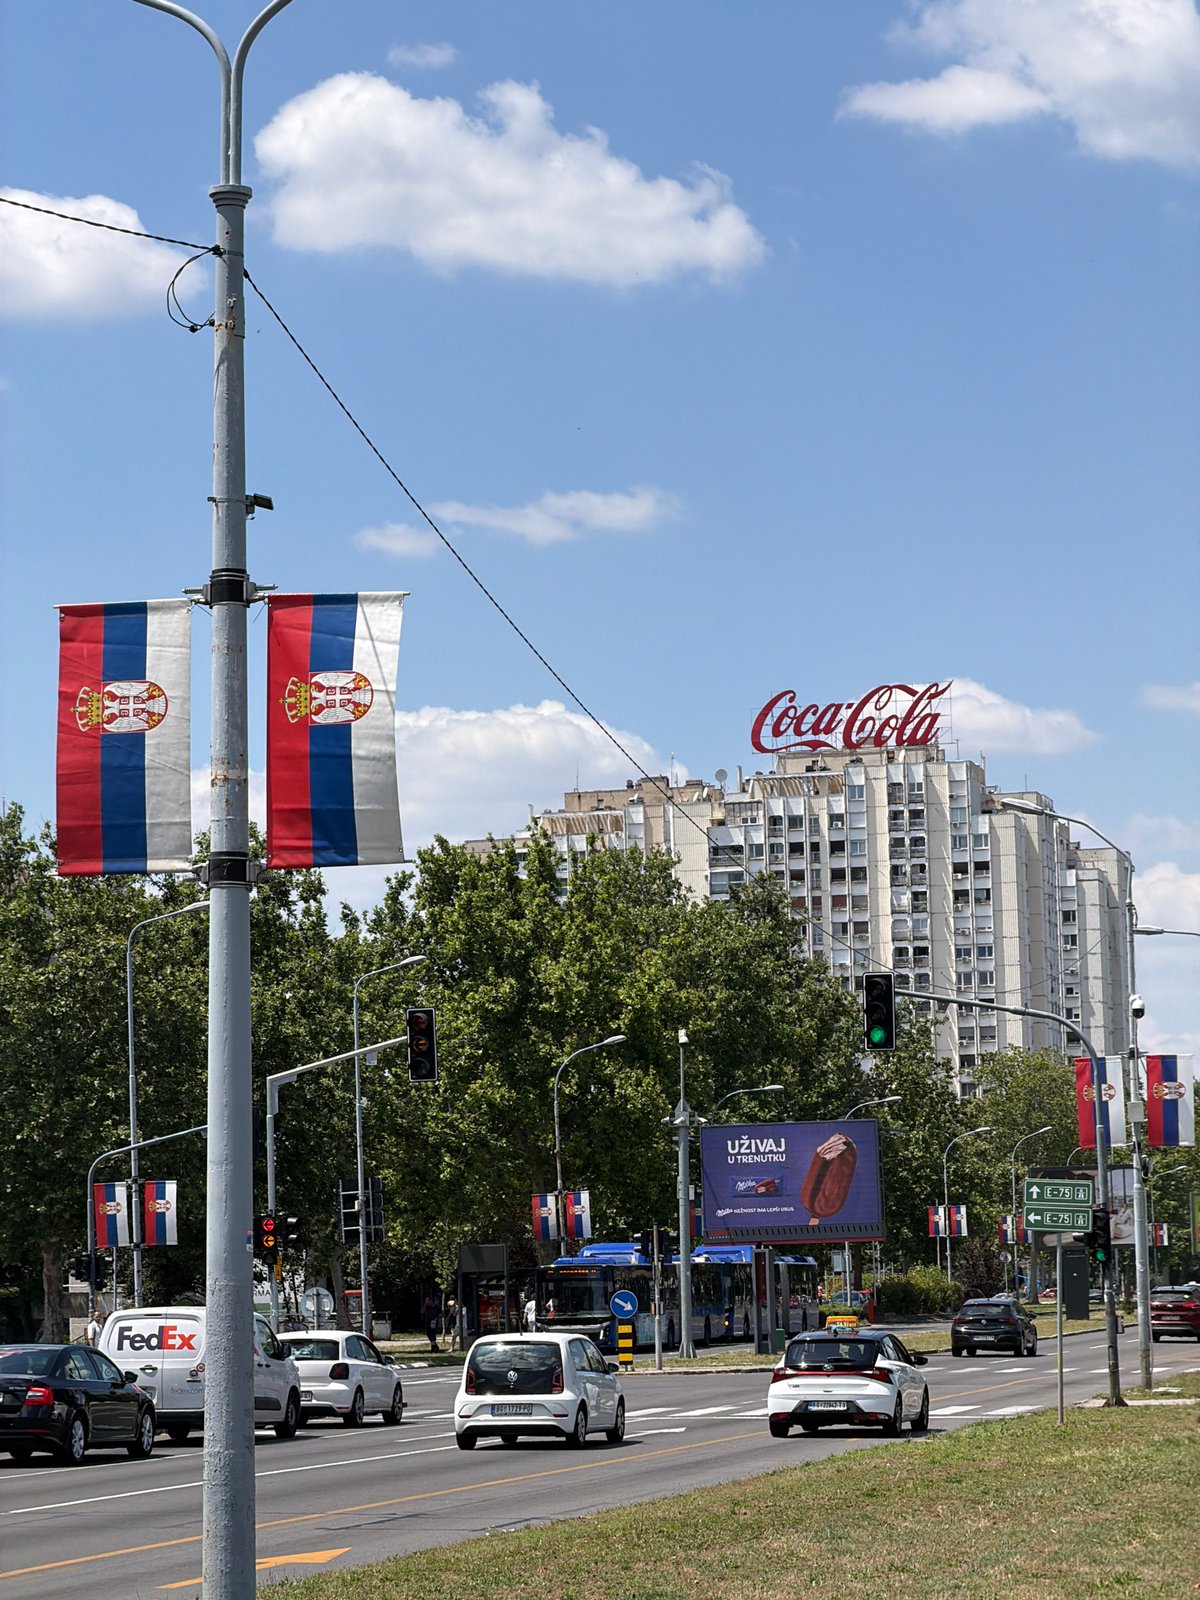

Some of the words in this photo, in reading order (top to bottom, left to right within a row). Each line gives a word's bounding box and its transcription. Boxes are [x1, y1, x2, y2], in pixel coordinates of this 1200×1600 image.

[750, 679, 954, 753] Coca-Cola
[727, 1134, 786, 1154] UŽIVAJ
[727, 1155, 735, 1164] U
[736, 1153, 786, 1163] TRENUTKU
[1046, 1187, 1070, 1198] E-75
[1046, 1213, 1070, 1224] E-75
[117, 1325, 197, 1351] FedEx
